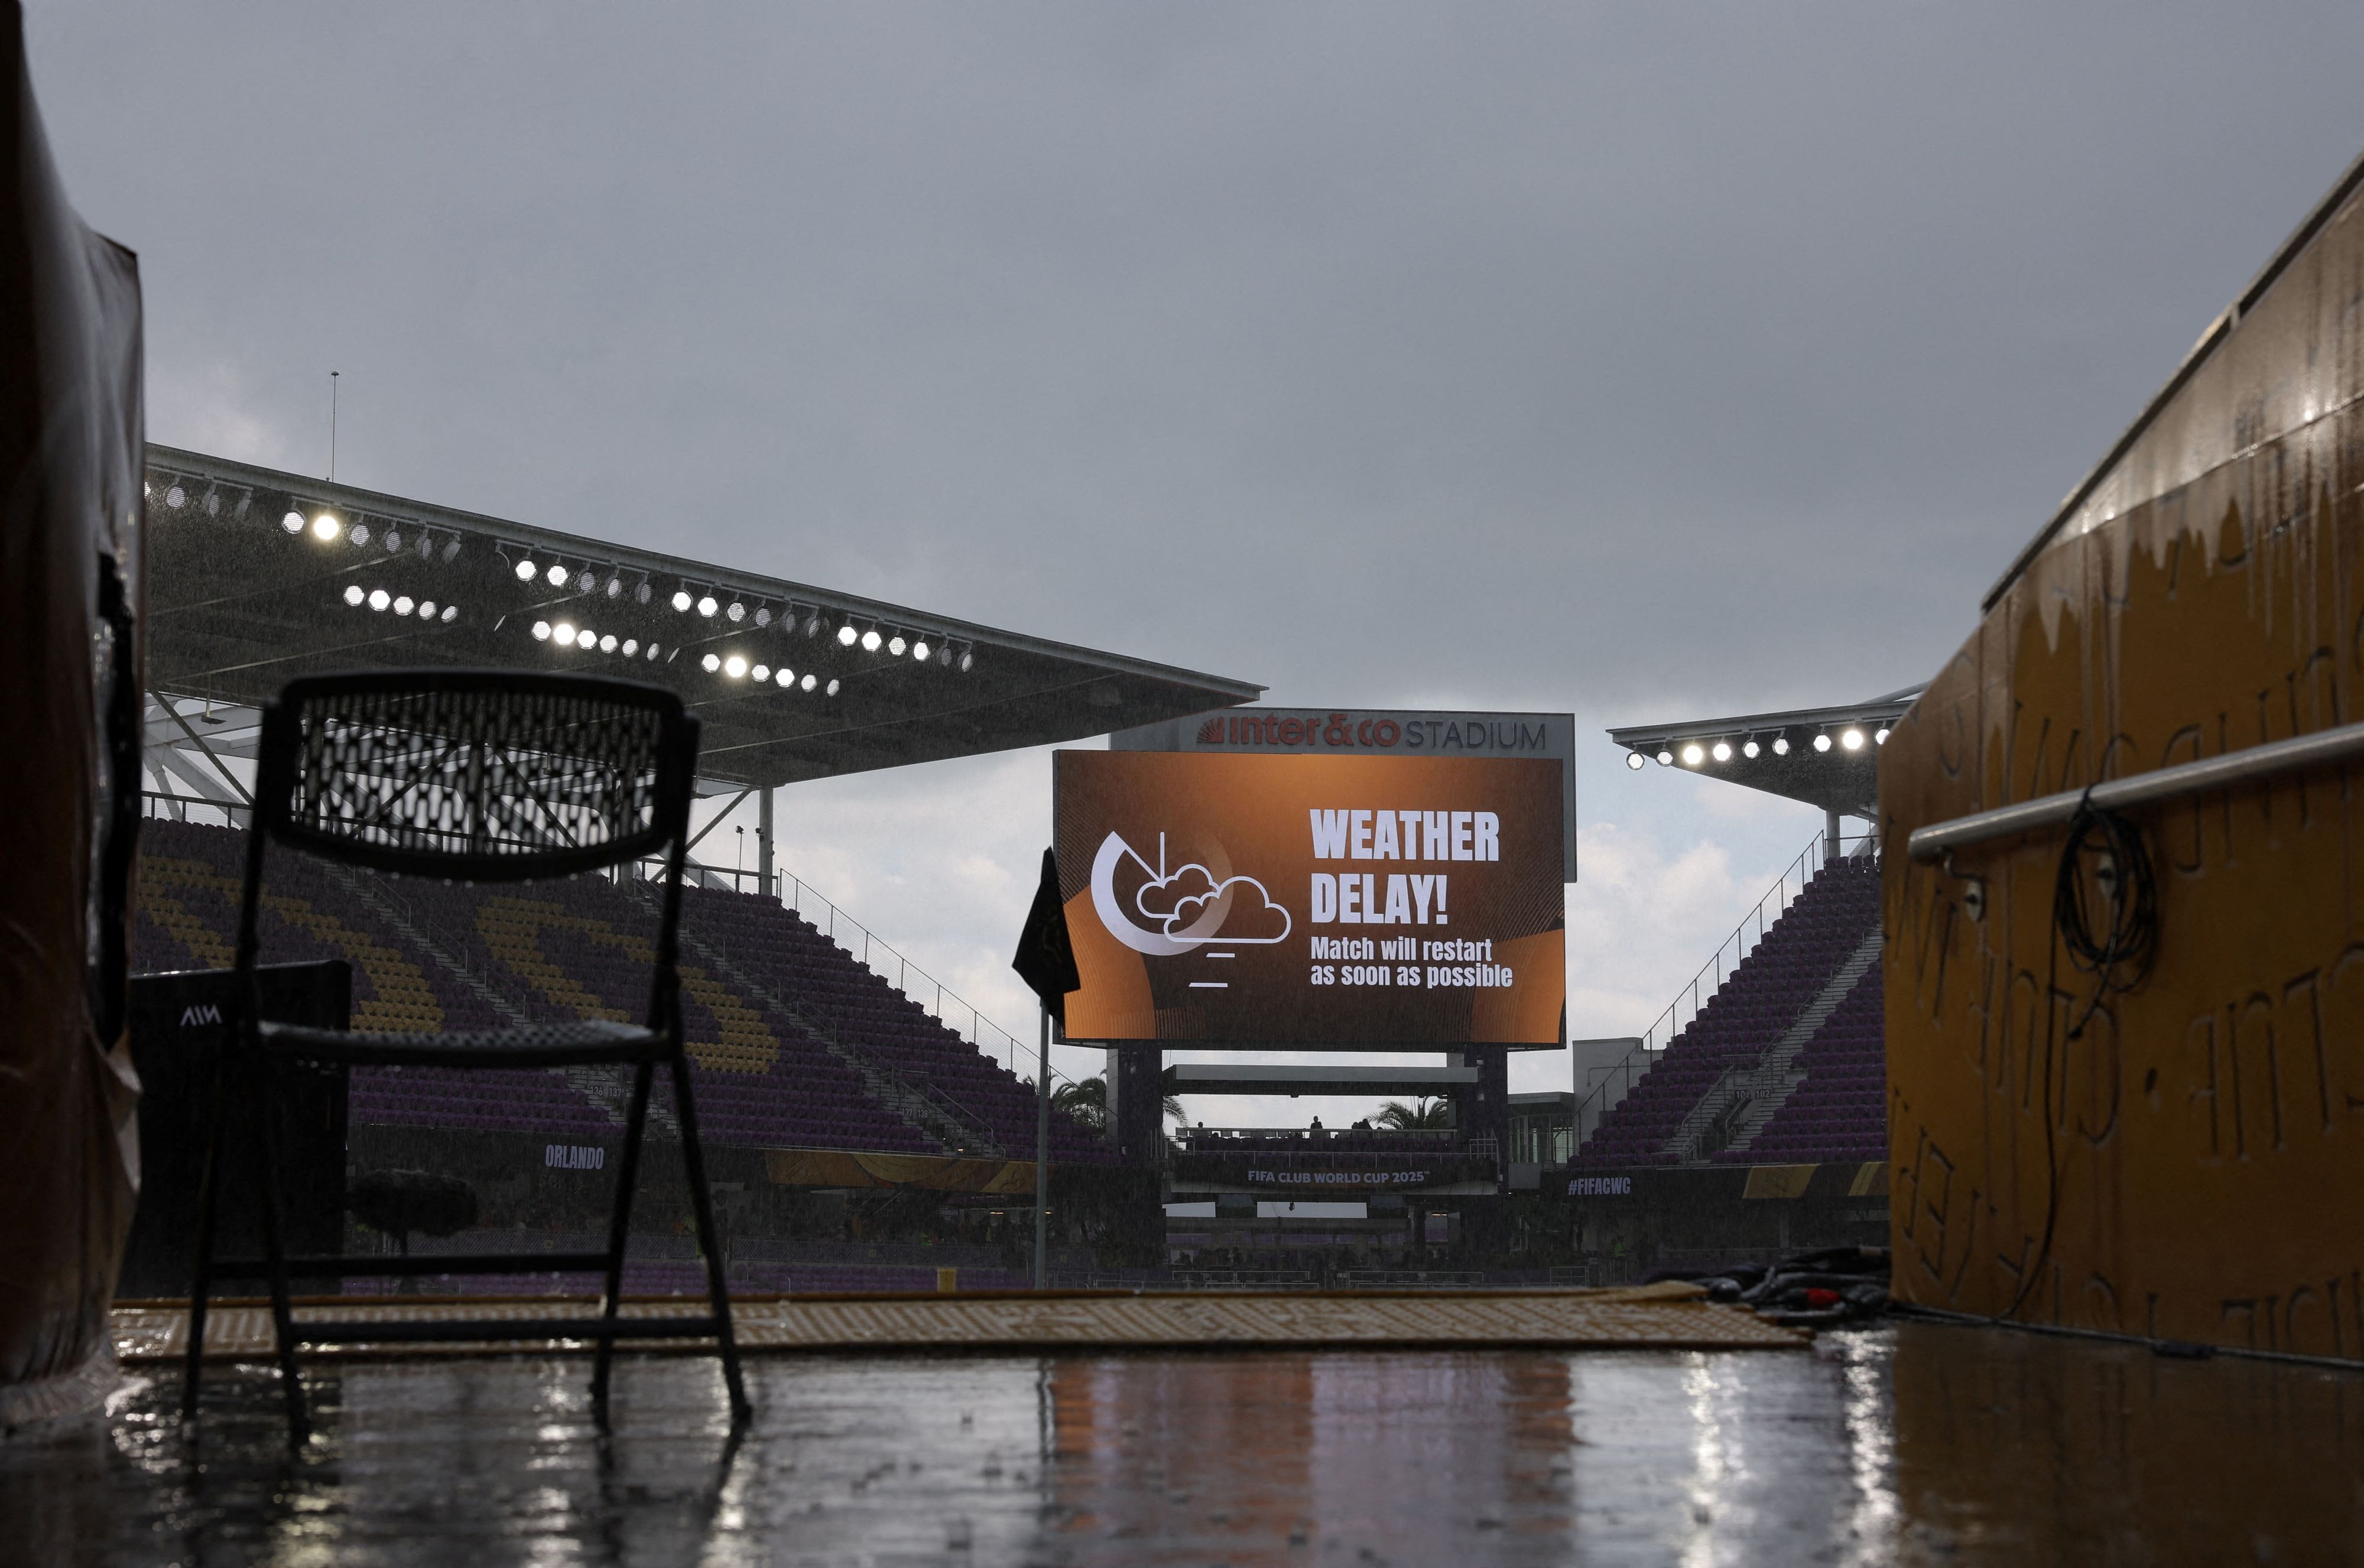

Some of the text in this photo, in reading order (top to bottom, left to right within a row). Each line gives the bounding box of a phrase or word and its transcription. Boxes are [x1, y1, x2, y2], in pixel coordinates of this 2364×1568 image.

[1405, 720, 1546, 750] STADIUM
[1310, 809, 1500, 861] WEATHER
[1311, 873, 1448, 924] DELAY!
[1311, 936, 1492, 962] Match will restart
[1311, 963, 1513, 989] as soon as possible
[590, 1086, 622, 1097] 136 137
[1755, 1089, 1771, 1098] 102
[545, 1144, 604, 1170] ORLANDO
[1248, 1171, 1275, 1181] FIFA
[1278, 1172, 1311, 1183] CLUB
[1314, 1173, 1361, 1183] WORLD
[1363, 1173, 1389, 1183] CUP
[1568, 1177, 1631, 1195] #FIFACWC
